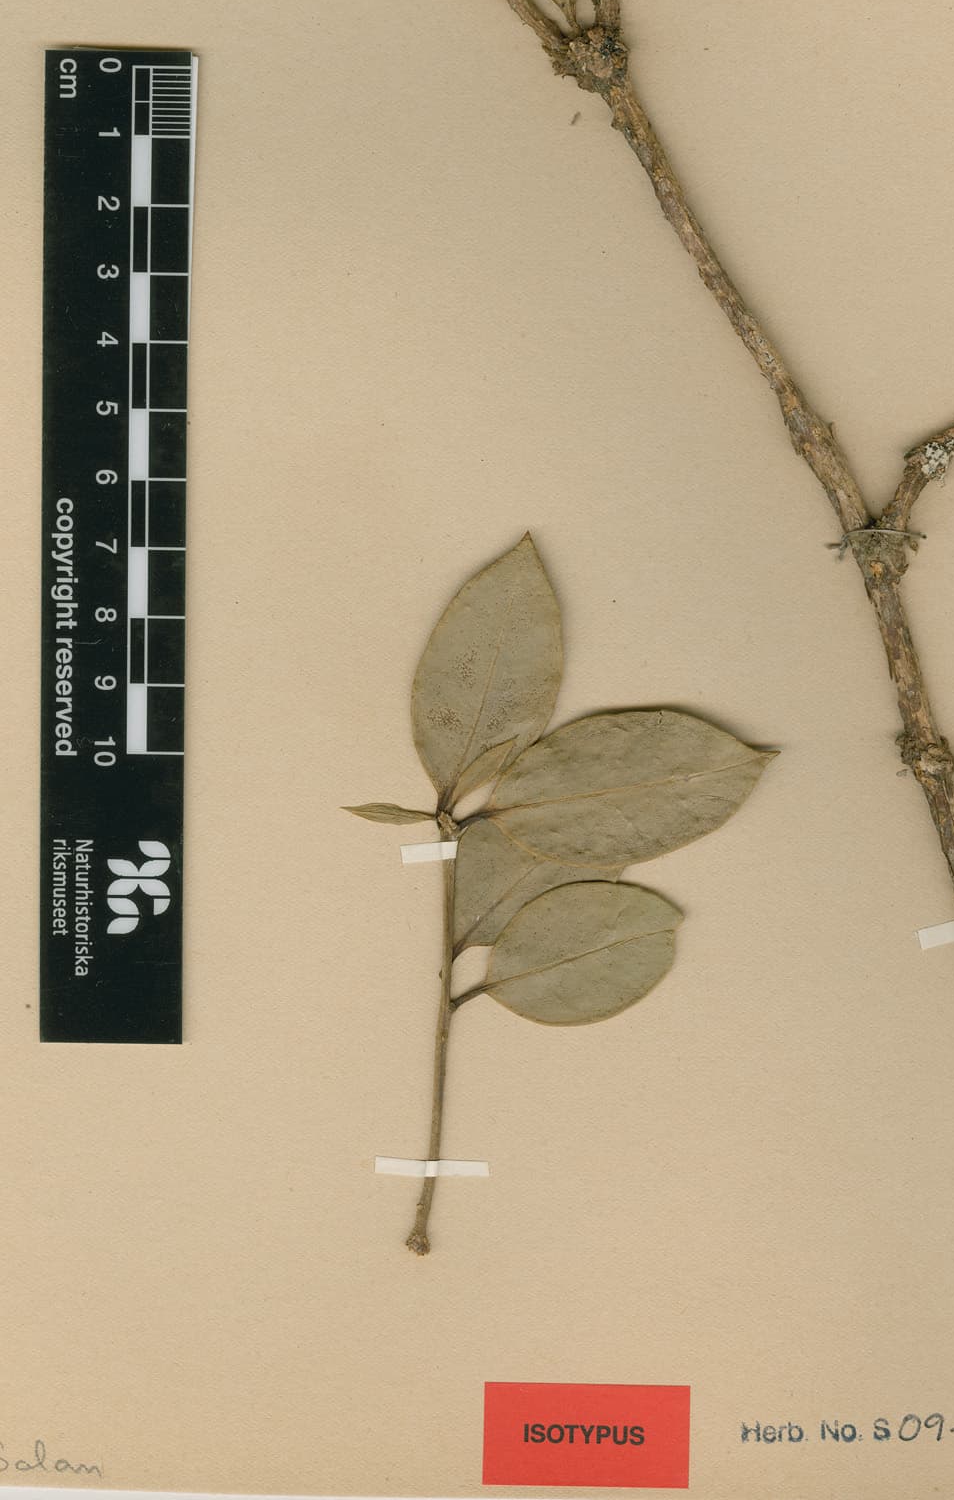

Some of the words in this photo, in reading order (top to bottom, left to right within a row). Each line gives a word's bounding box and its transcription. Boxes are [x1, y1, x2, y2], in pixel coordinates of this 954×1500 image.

[99, 57, 122, 73] 0
[59, 58, 77, 98] cm
[98, 127, 121, 137] 1
[97, 196, 121, 212] 2
[97, 264, 119, 280] 3
[96, 331, 119, 347] 4
[96, 400, 118, 416] 5
[95, 469, 118, 485] 6
[95, 538, 117, 555] 7
[51, 497, 79, 629] copyright
[95, 607, 117, 623] 8
[94, 675, 117, 691] 9
[55, 638, 78, 756] reserved
[93, 736, 117, 767] 10
[53, 839, 72, 936] riksmuseet
[75, 839, 93, 977] Naturhistoriska
[524, 1422, 646, 1446] ISOTYPUS
[741, 1419, 808, 1444] Herb.
[820, 1420, 864, 1444] No.
